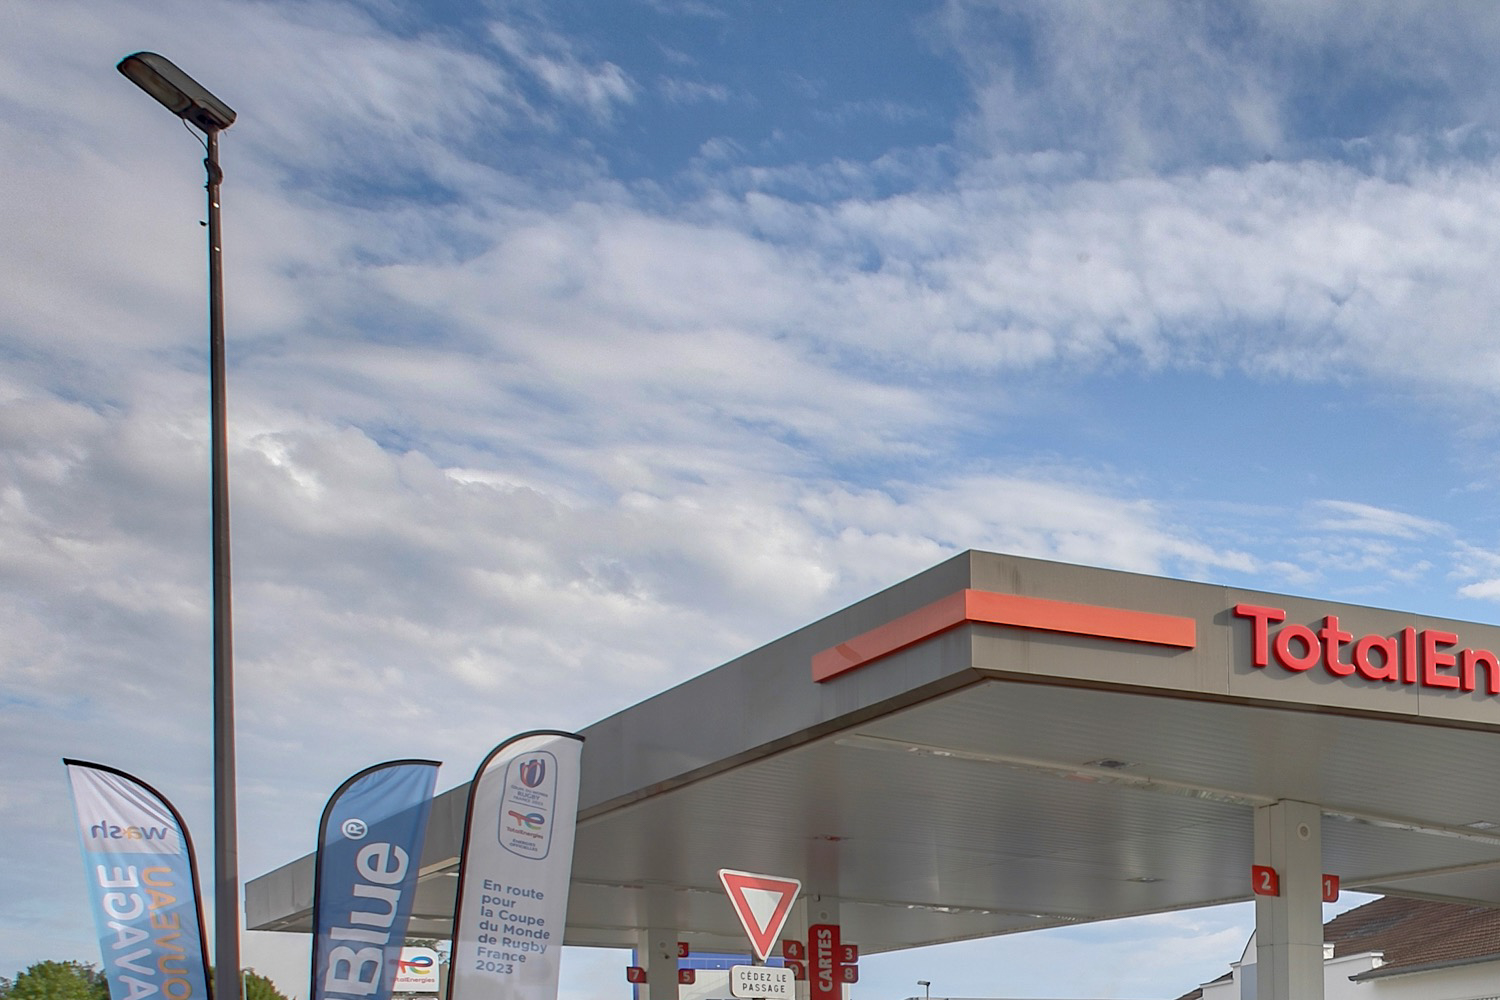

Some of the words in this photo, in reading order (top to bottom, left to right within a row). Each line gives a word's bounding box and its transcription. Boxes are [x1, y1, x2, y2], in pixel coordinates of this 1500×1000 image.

[1261, 871, 1272, 890] 2
[483, 879, 502, 892] En
[506, 885, 544, 900] route
[1324, 879, 1331, 897] 1
[481, 894, 516, 908] pour
[480, 906, 494, 918] la
[498, 910, 545, 926] Coupe
[479, 920, 498, 932] du
[503, 924, 550, 940] Monde
[478, 934, 497, 945] de
[502, 937, 547, 954] Rugby
[788, 944, 797, 956] 4
[477, 946, 527, 963] France
[817, 929, 833, 992] CARTES
[845, 948, 853, 960] 3
[475, 960, 514, 974] 2023
[844, 968, 854, 980] 8
[633, 970, 640, 980] 7
[683, 972, 691, 981] 5
[740, 971, 771, 981] CÉDEZ
[776, 974, 787, 983] LE
[742, 983, 786, 993] PASSAGE
